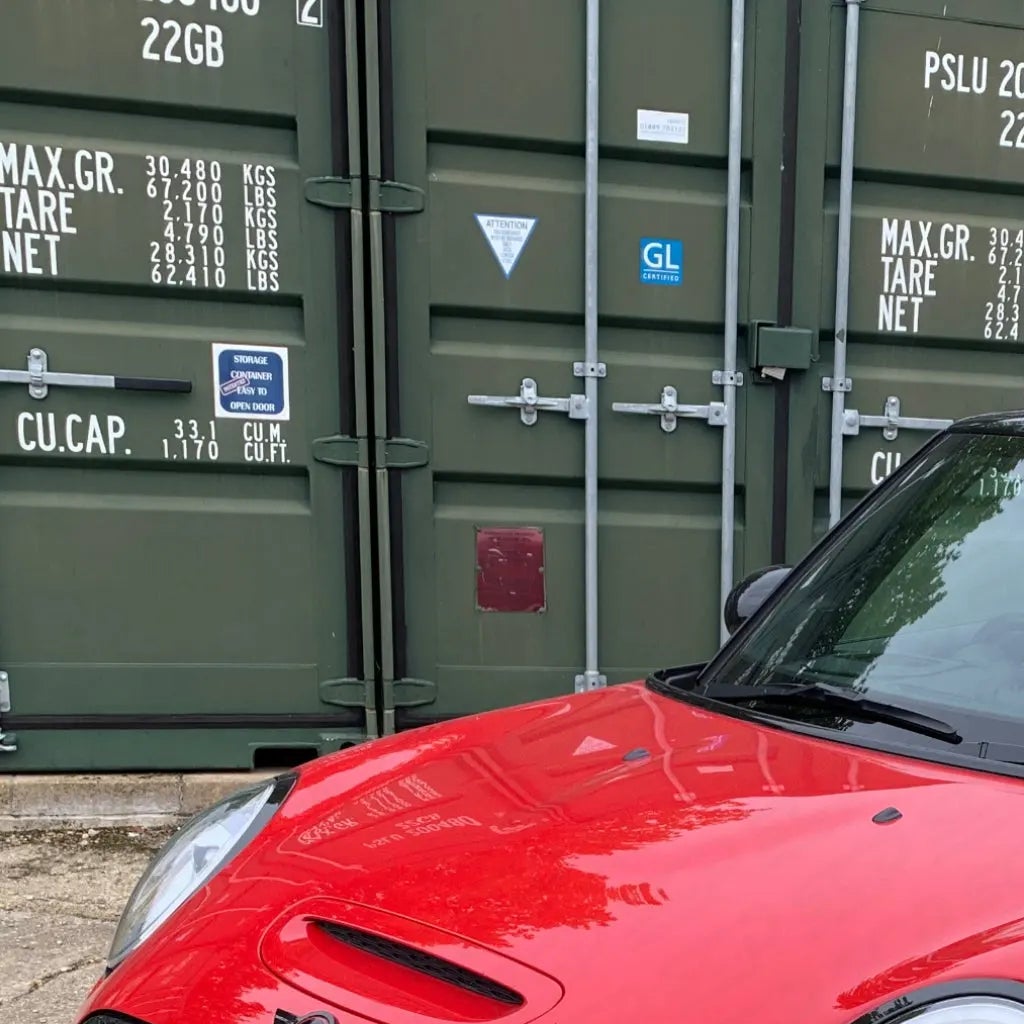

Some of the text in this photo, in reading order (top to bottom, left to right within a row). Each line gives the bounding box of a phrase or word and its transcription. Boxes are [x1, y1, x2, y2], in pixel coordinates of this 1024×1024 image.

[140, 17, 224, 67] 22GB
[924, 50, 988, 94] PSLU
[0, 142, 124, 194] MAX.GR.
[243, 164, 276, 186] KGS
[244, 185, 277, 208] LBS
[0, 186, 77, 234] TARE
[244, 206, 277, 229] KGS
[486, 219, 528, 230] ATTENTION
[245, 227, 278, 250] LBS
[881, 217, 975, 262] MAX.GR.
[2, 230, 60, 276] NET
[246, 248, 279, 271] KGS
[643, 242, 680, 269] GL
[247, 269, 279, 292] LBS
[642, 272, 680, 281] CERTIFIED
[880, 256, 938, 296] TARE
[878, 295, 923, 333] NET
[233, 354, 269, 365] STORAGE
[230, 370, 273, 381] CONTAINER
[237, 386, 268, 396] EASY TO
[230, 401, 275, 412] OPEN DOOR
[17, 412, 286, 455] CU.CAP. 33.1 CU.M.
[244, 442, 291, 463] CU.FT.
